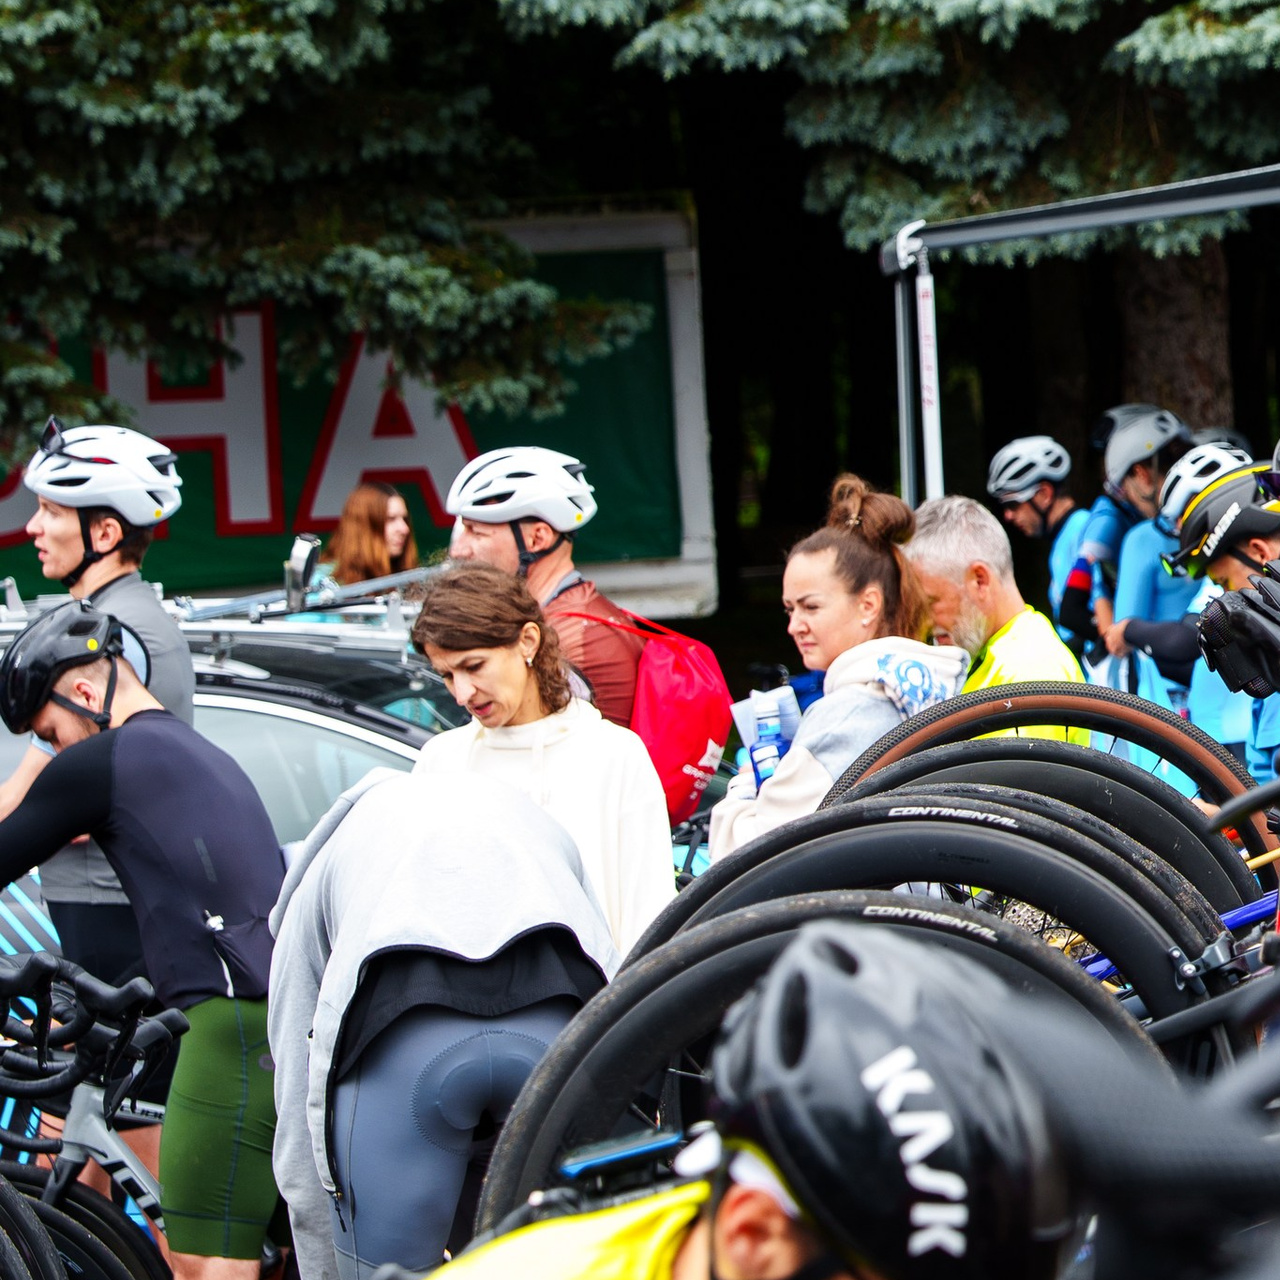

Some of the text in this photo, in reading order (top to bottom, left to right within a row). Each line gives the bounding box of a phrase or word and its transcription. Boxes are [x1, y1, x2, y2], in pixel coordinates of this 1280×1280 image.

[0, 300, 485, 548] НА
[888, 806, 1019, 829] CONTINENTAL
[862, 905, 999, 942] CONTINENTAL
[860, 1044, 969, 1259] KASK
